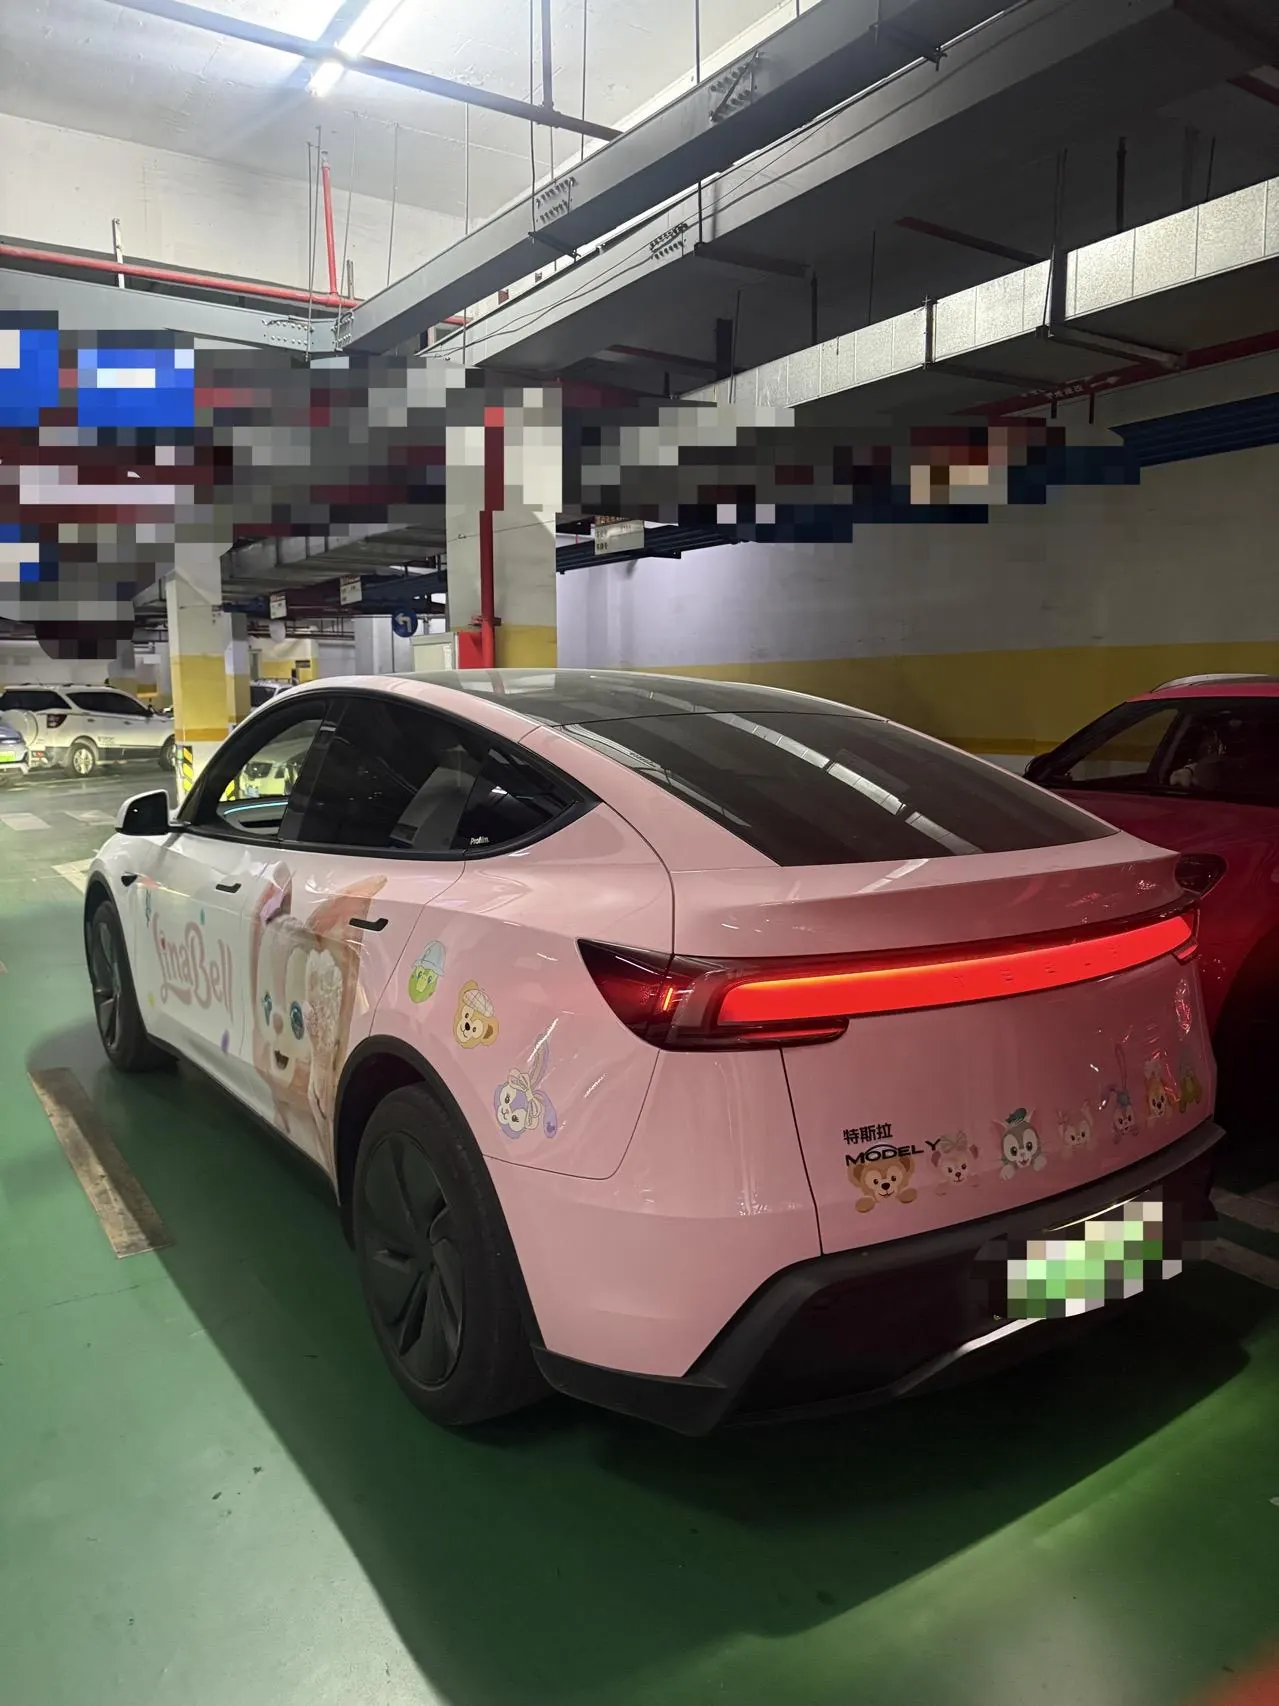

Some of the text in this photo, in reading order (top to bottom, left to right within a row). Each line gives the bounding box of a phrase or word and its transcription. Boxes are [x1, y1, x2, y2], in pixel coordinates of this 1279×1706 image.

[843, 1122, 893, 1145] 特斯拉
[845, 1144, 925, 1167] MODEL
